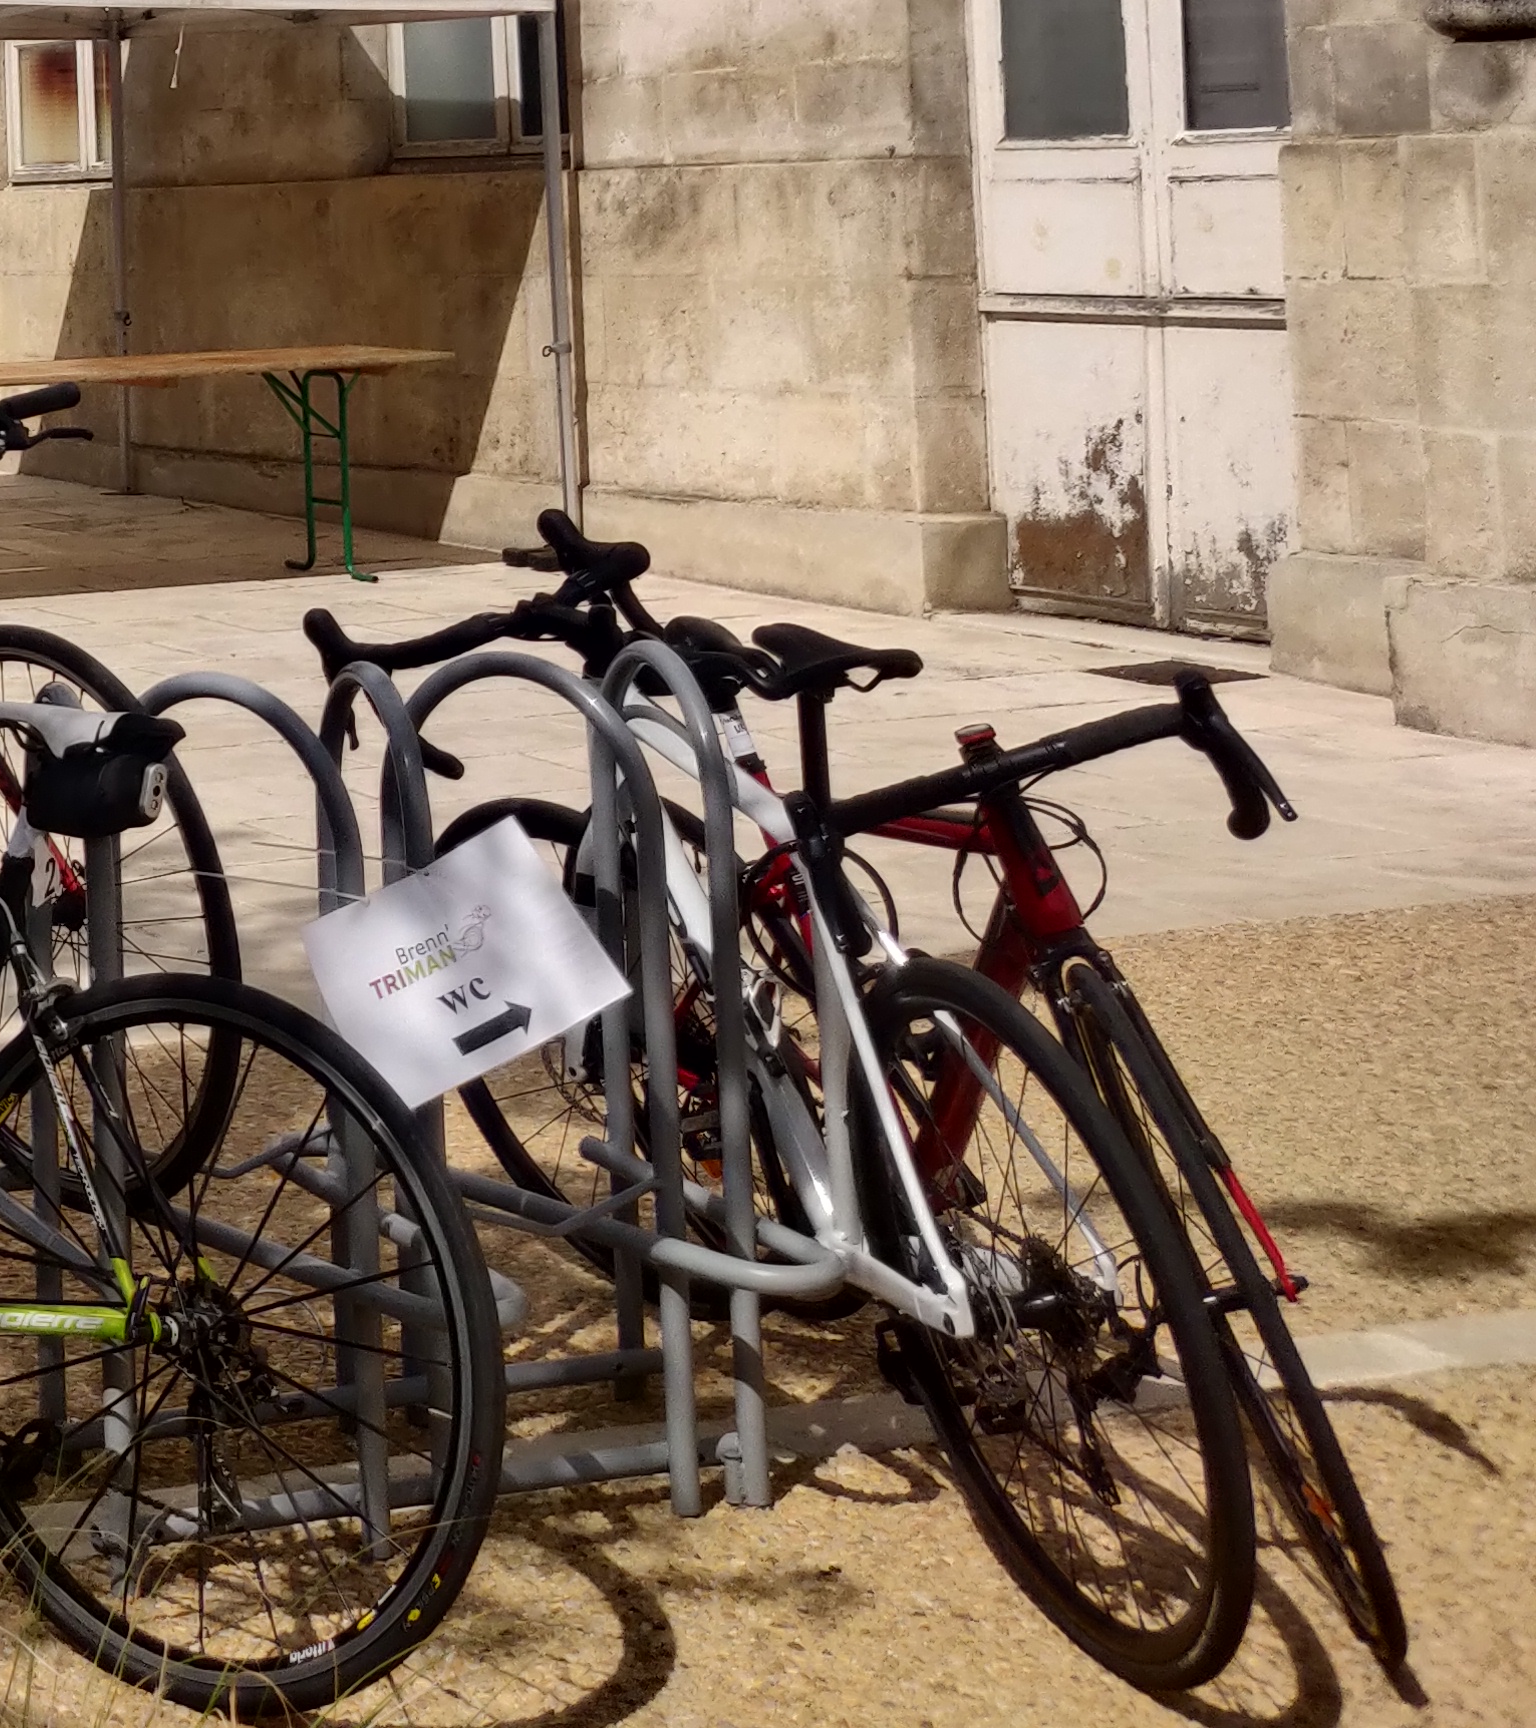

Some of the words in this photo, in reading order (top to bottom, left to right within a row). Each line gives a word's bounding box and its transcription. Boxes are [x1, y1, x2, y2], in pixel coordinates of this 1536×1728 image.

[395, 923, 449, 966] Brenn'
[368, 944, 457, 1000] TRIMAN
[435, 977, 492, 1015] WC
